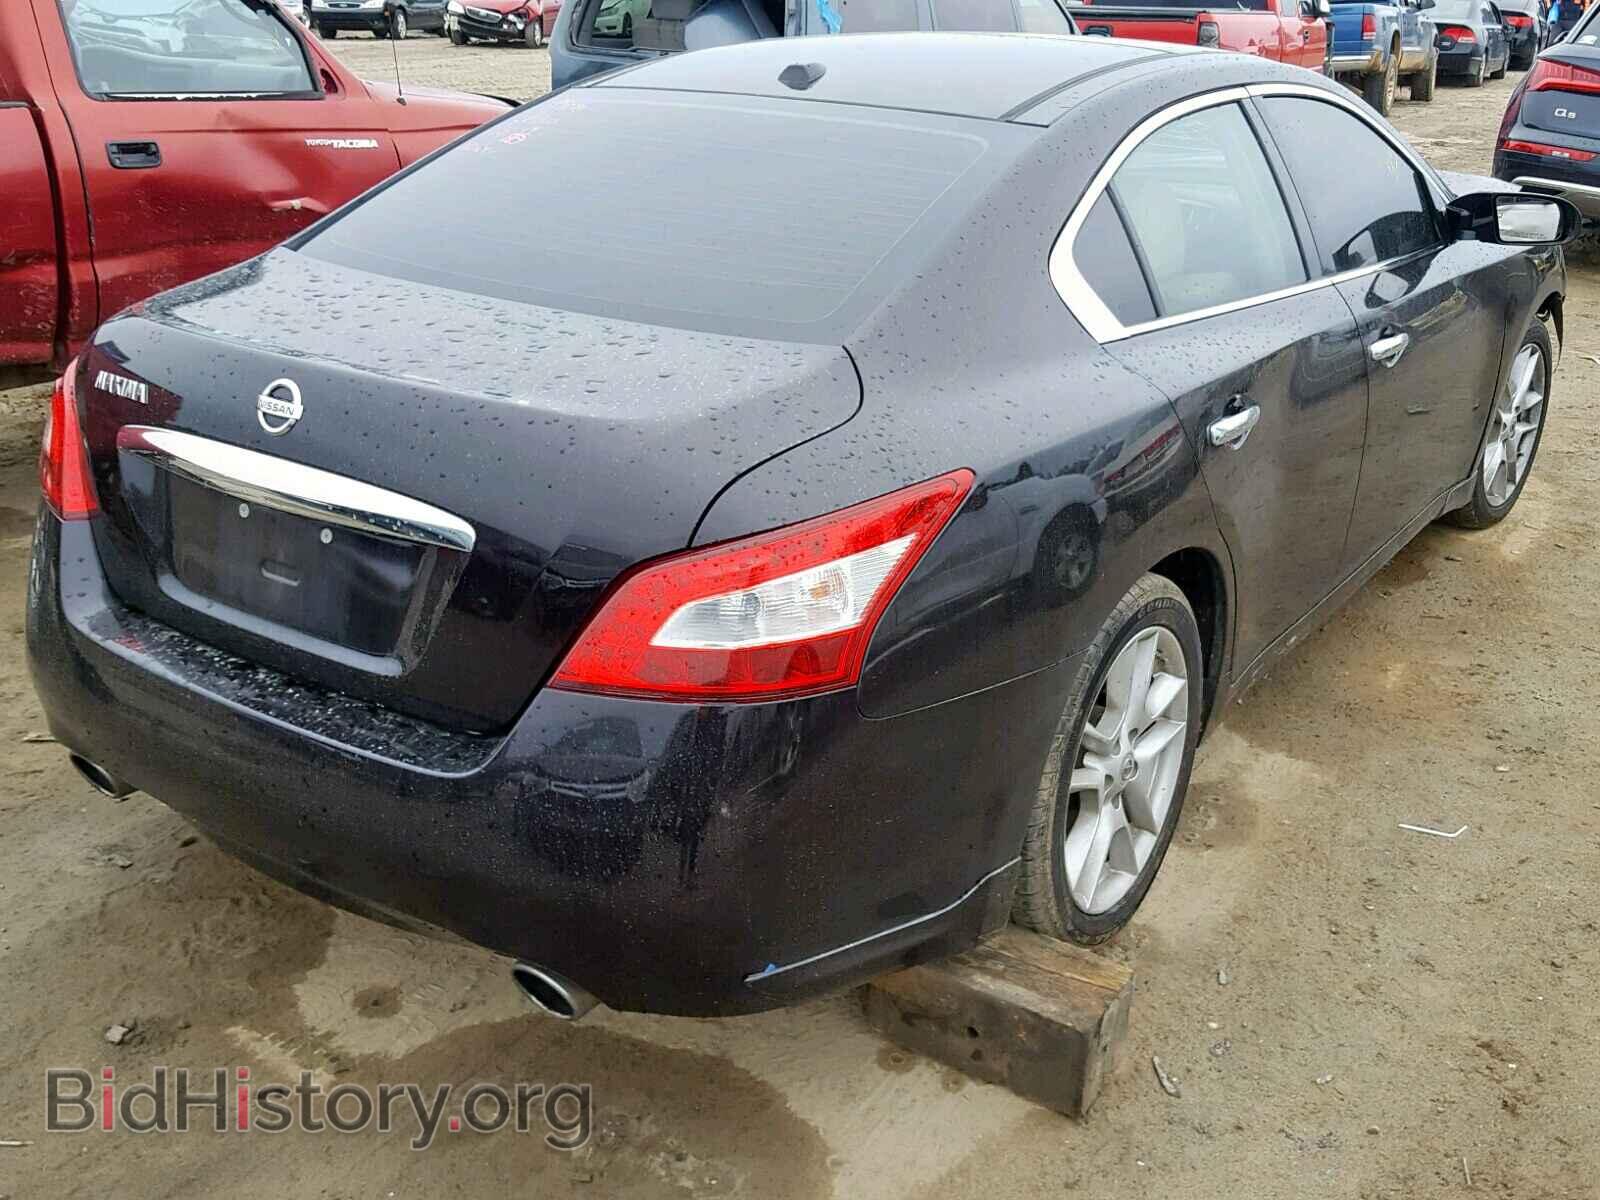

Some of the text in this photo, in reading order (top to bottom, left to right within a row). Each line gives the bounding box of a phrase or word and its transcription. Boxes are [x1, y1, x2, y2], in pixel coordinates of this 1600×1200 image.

[333, 139, 379, 149] TACOMA
[94, 370, 149, 405] MAXIMA
[257, 399, 296, 416] NISSAN
